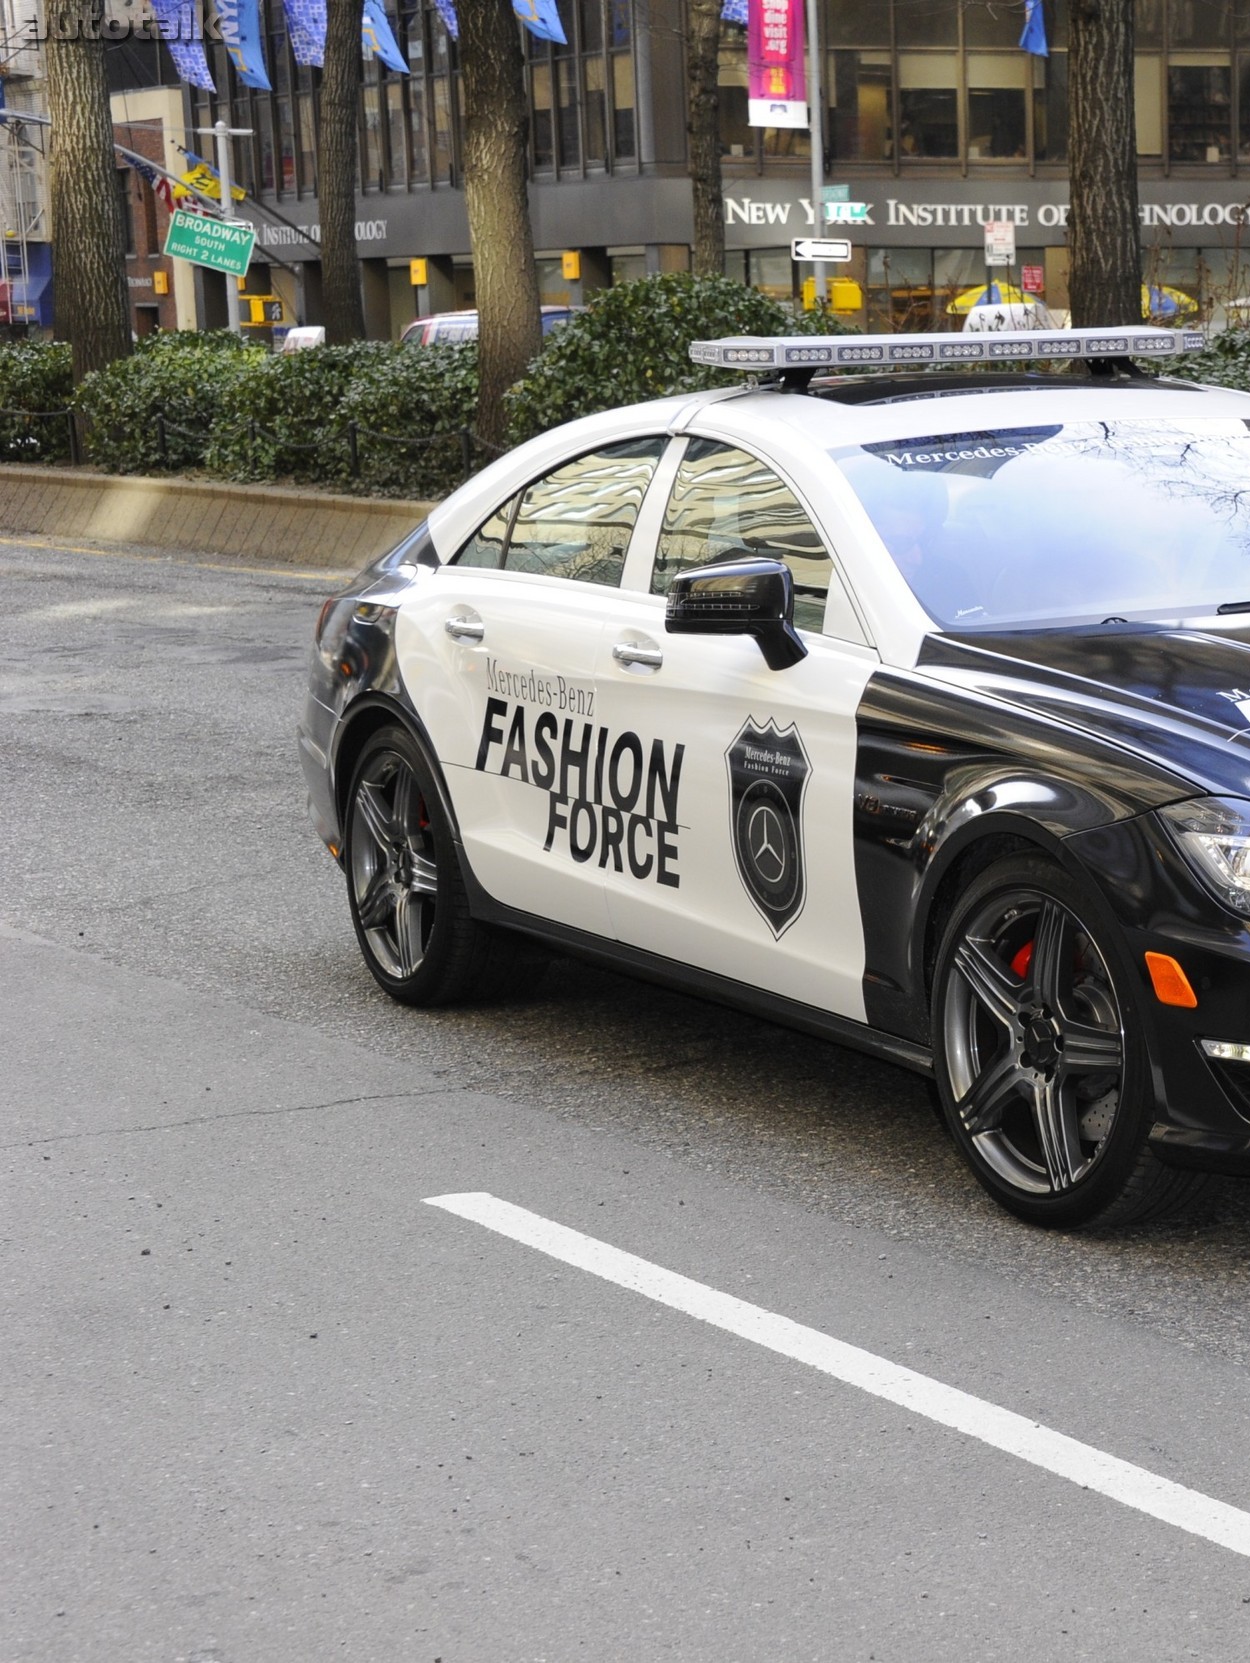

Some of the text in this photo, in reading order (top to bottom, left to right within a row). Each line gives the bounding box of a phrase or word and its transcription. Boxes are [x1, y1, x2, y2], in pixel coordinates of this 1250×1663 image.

[764, 9, 787, 24] dine
[763, 24, 787, 38] visit
[765, 39, 787, 54] .org
[725, 198, 791, 225] NEW
[886, 199, 1029, 226] INSTITUTE
[175, 214, 250, 246] BROADWAY
[194, 235, 226, 252] SOUTH
[170, 242, 242, 270] RIGHT 2 LANES
[486, 657, 595, 717] Mercedes-Benz
[475, 696, 685, 827] FASHION
[744, 746, 791, 766] Mercedes-Benz
[744, 760, 789, 776] Fashion Force
[543, 794, 680, 889] FORCE
